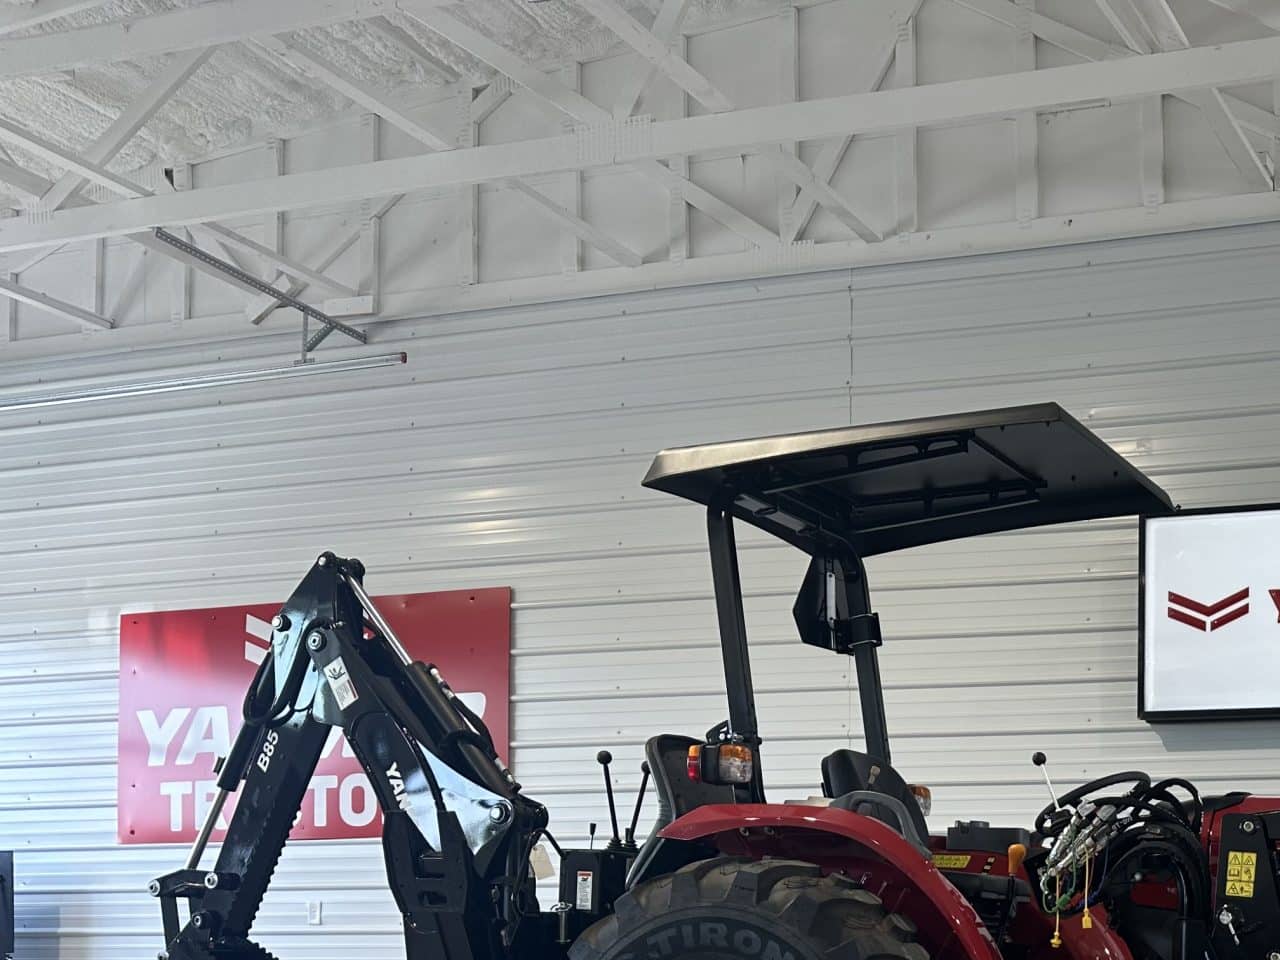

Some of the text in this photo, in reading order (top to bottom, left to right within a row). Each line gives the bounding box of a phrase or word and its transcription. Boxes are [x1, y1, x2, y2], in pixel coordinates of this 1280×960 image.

[257, 729, 279, 773] B85
[160, 778, 384, 832] TRTO
[386, 761, 413, 812] YAN
